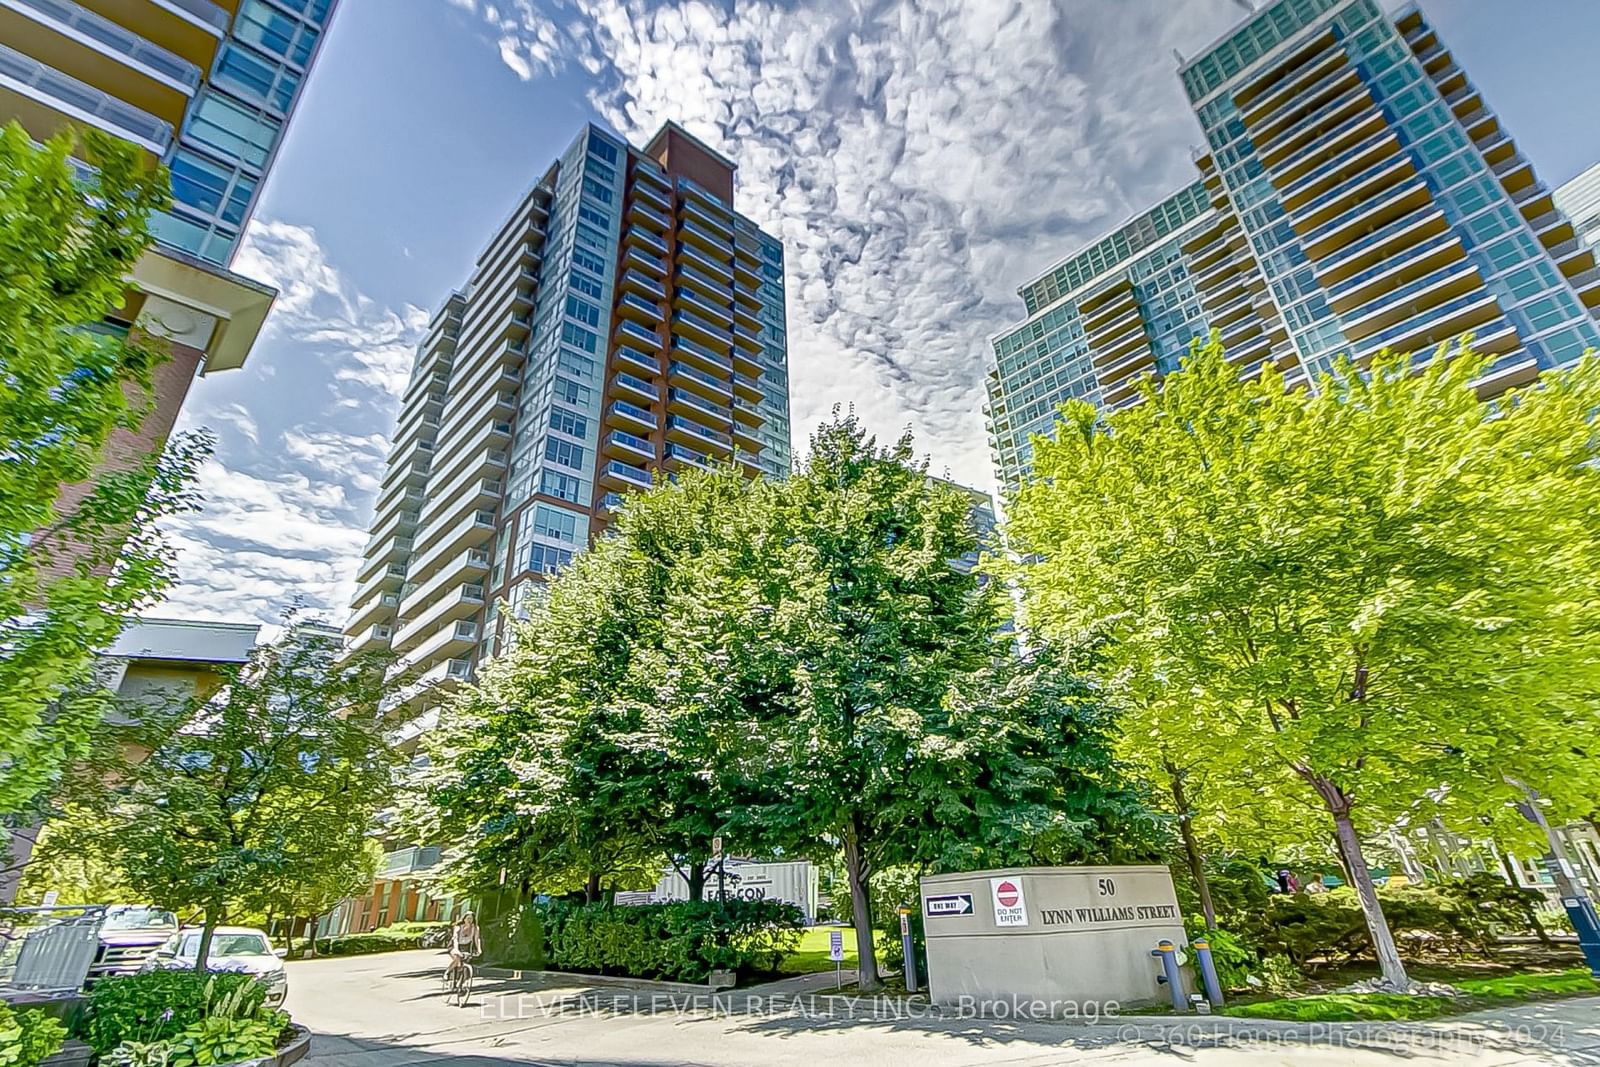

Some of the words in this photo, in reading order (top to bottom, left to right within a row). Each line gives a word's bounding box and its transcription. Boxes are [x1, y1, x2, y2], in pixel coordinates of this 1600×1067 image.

[1098, 879, 1115, 896] 50
[1000, 915, 1023, 923] ENTER
[1041, 910, 1074, 925] LYNN
[1075, 906, 1135, 922] WILLIAMS
[1136, 905, 1176, 920] STREET
